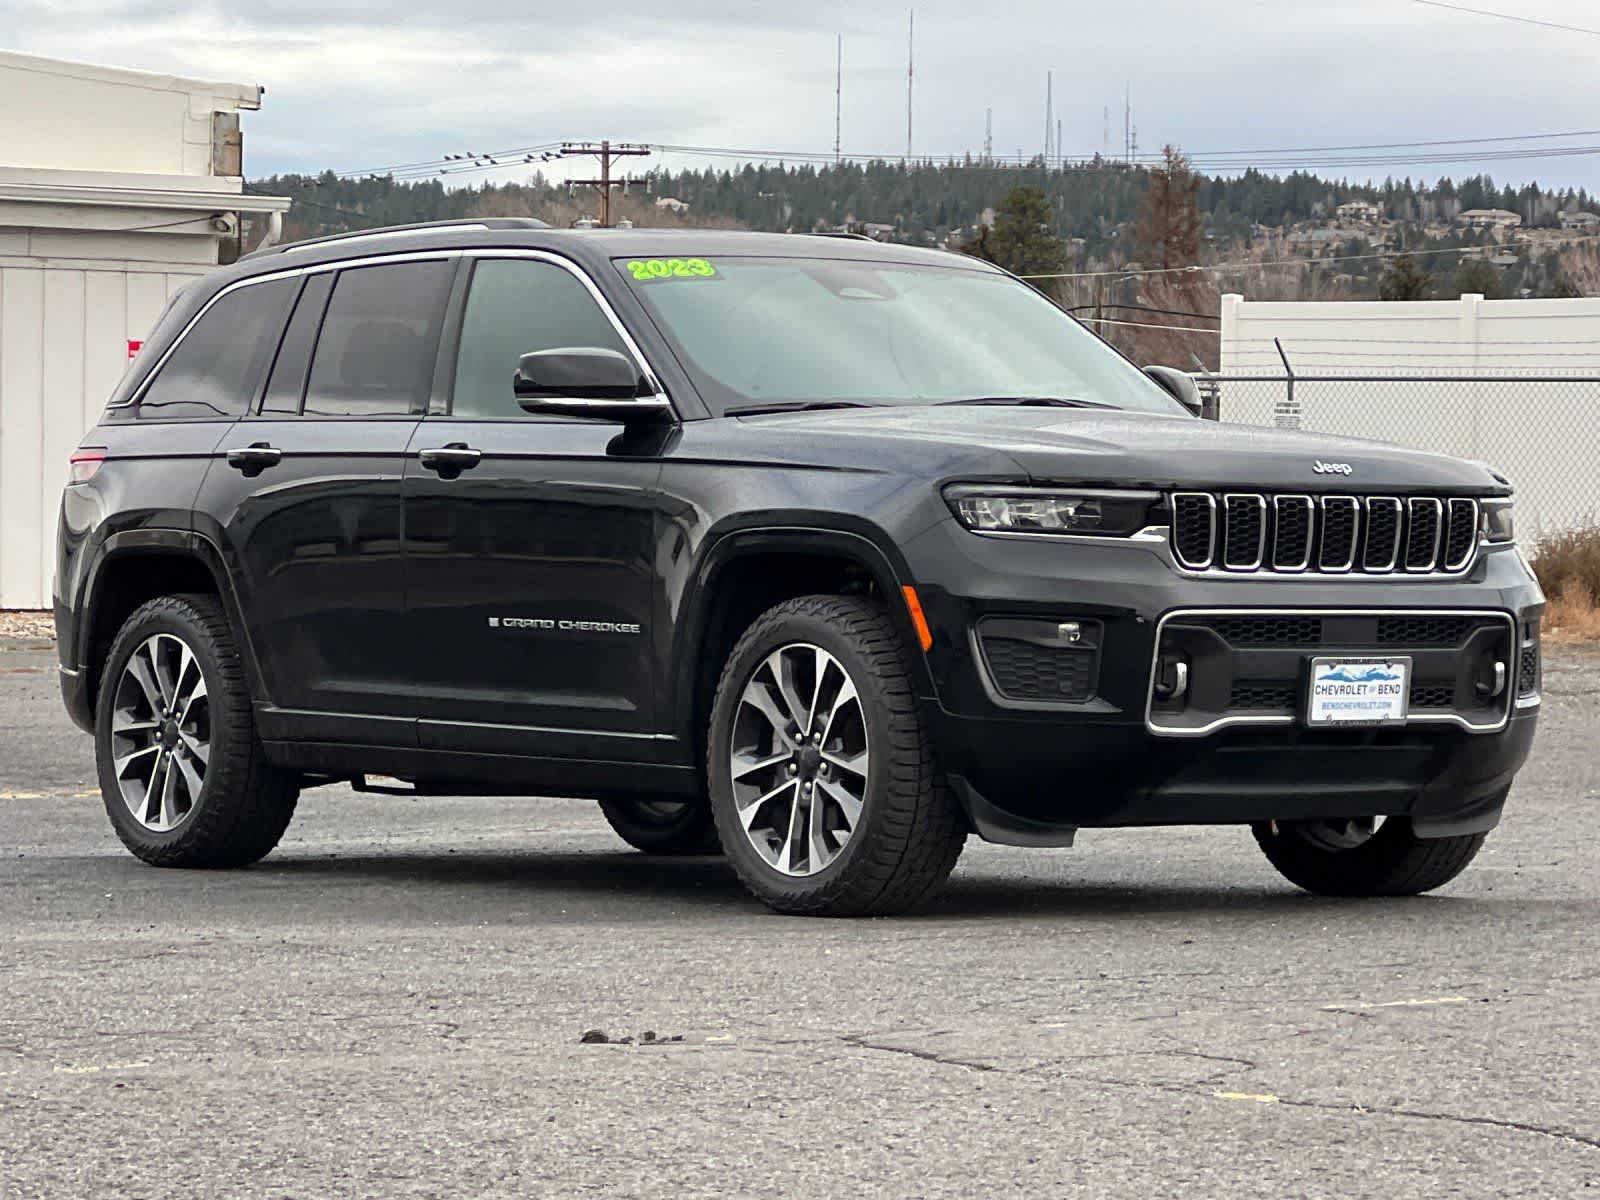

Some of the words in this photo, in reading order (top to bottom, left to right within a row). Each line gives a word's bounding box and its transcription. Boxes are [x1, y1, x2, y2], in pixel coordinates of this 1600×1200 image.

[627, 259, 715, 280] 2023
[1312, 460, 1352, 475] Jeep
[502, 617, 555, 629] GRAND
[558, 620, 641, 633] CHEROKEE
[1315, 684, 1368, 695] CHEVROLET
[1378, 684, 1401, 694] BEND
